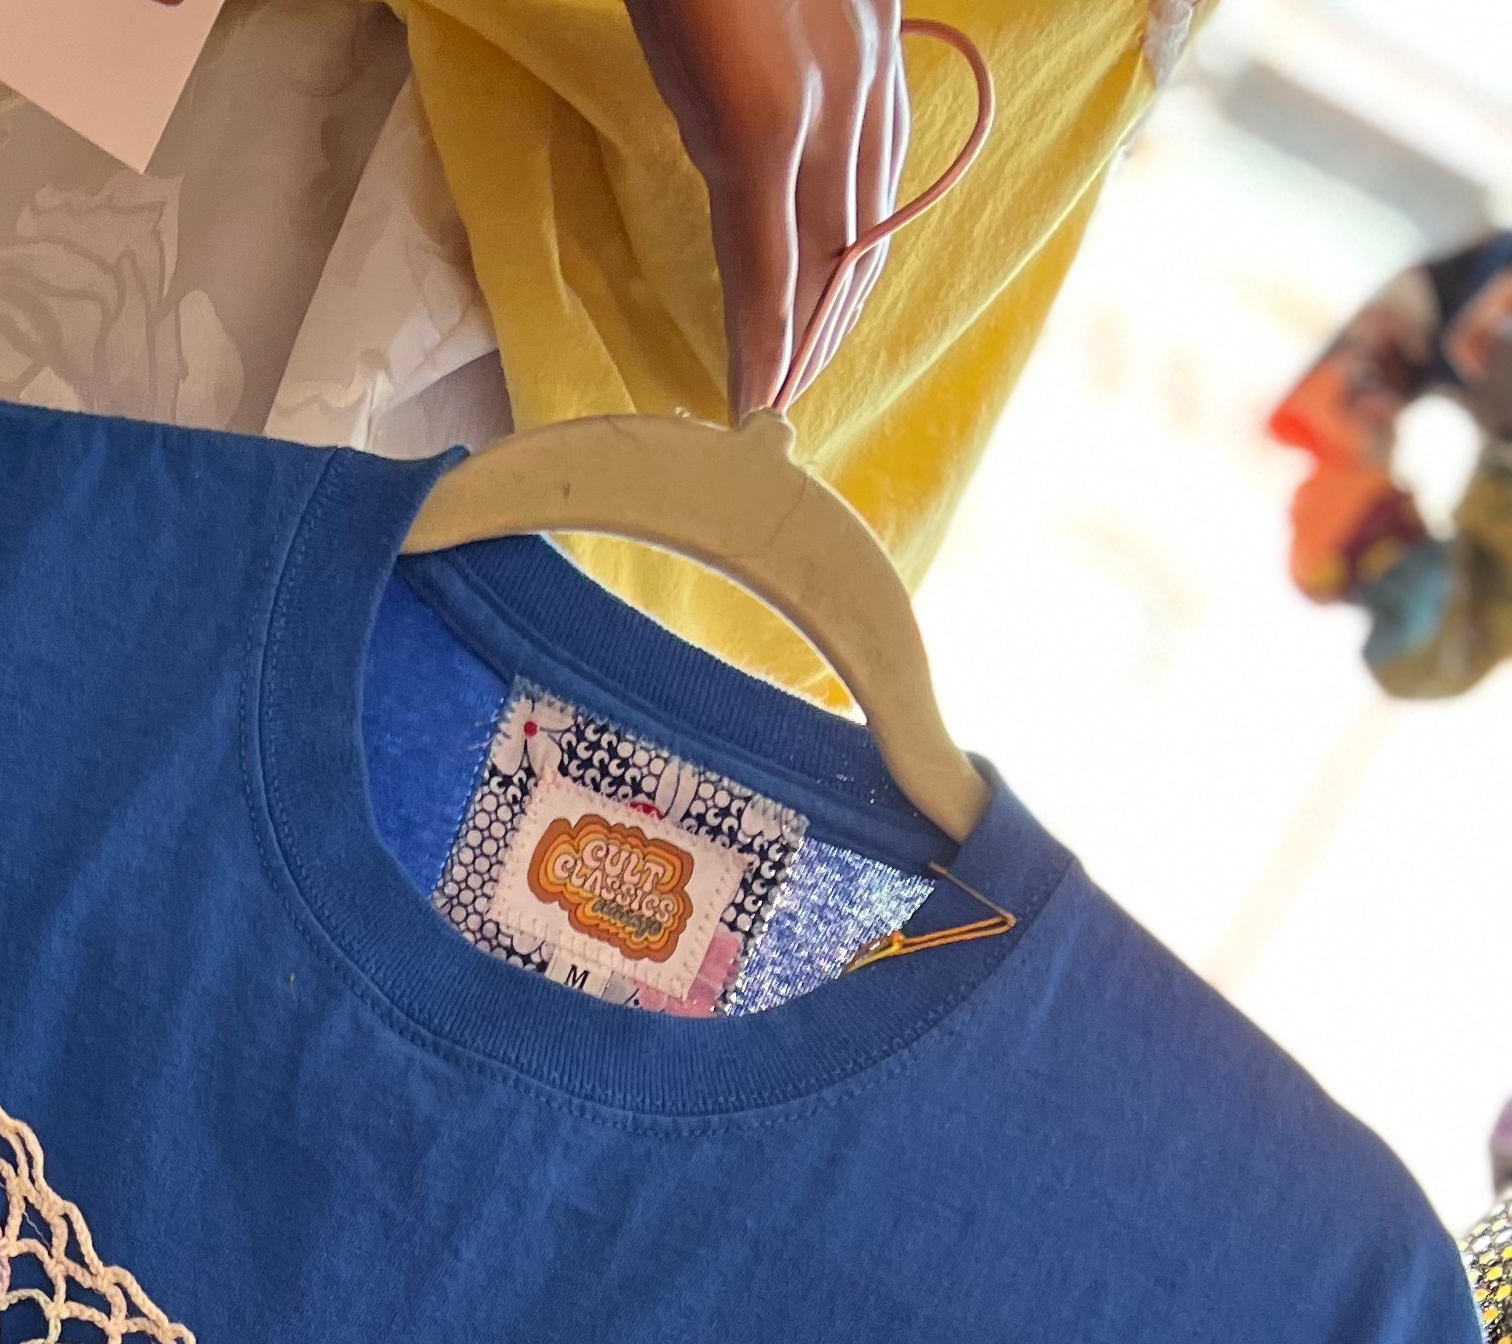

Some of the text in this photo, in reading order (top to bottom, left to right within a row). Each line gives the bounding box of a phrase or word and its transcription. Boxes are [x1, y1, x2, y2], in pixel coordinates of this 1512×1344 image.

[554, 853, 674, 923] CLASSICS
[582, 839, 665, 893] CULT
[564, 964, 590, 990] M
